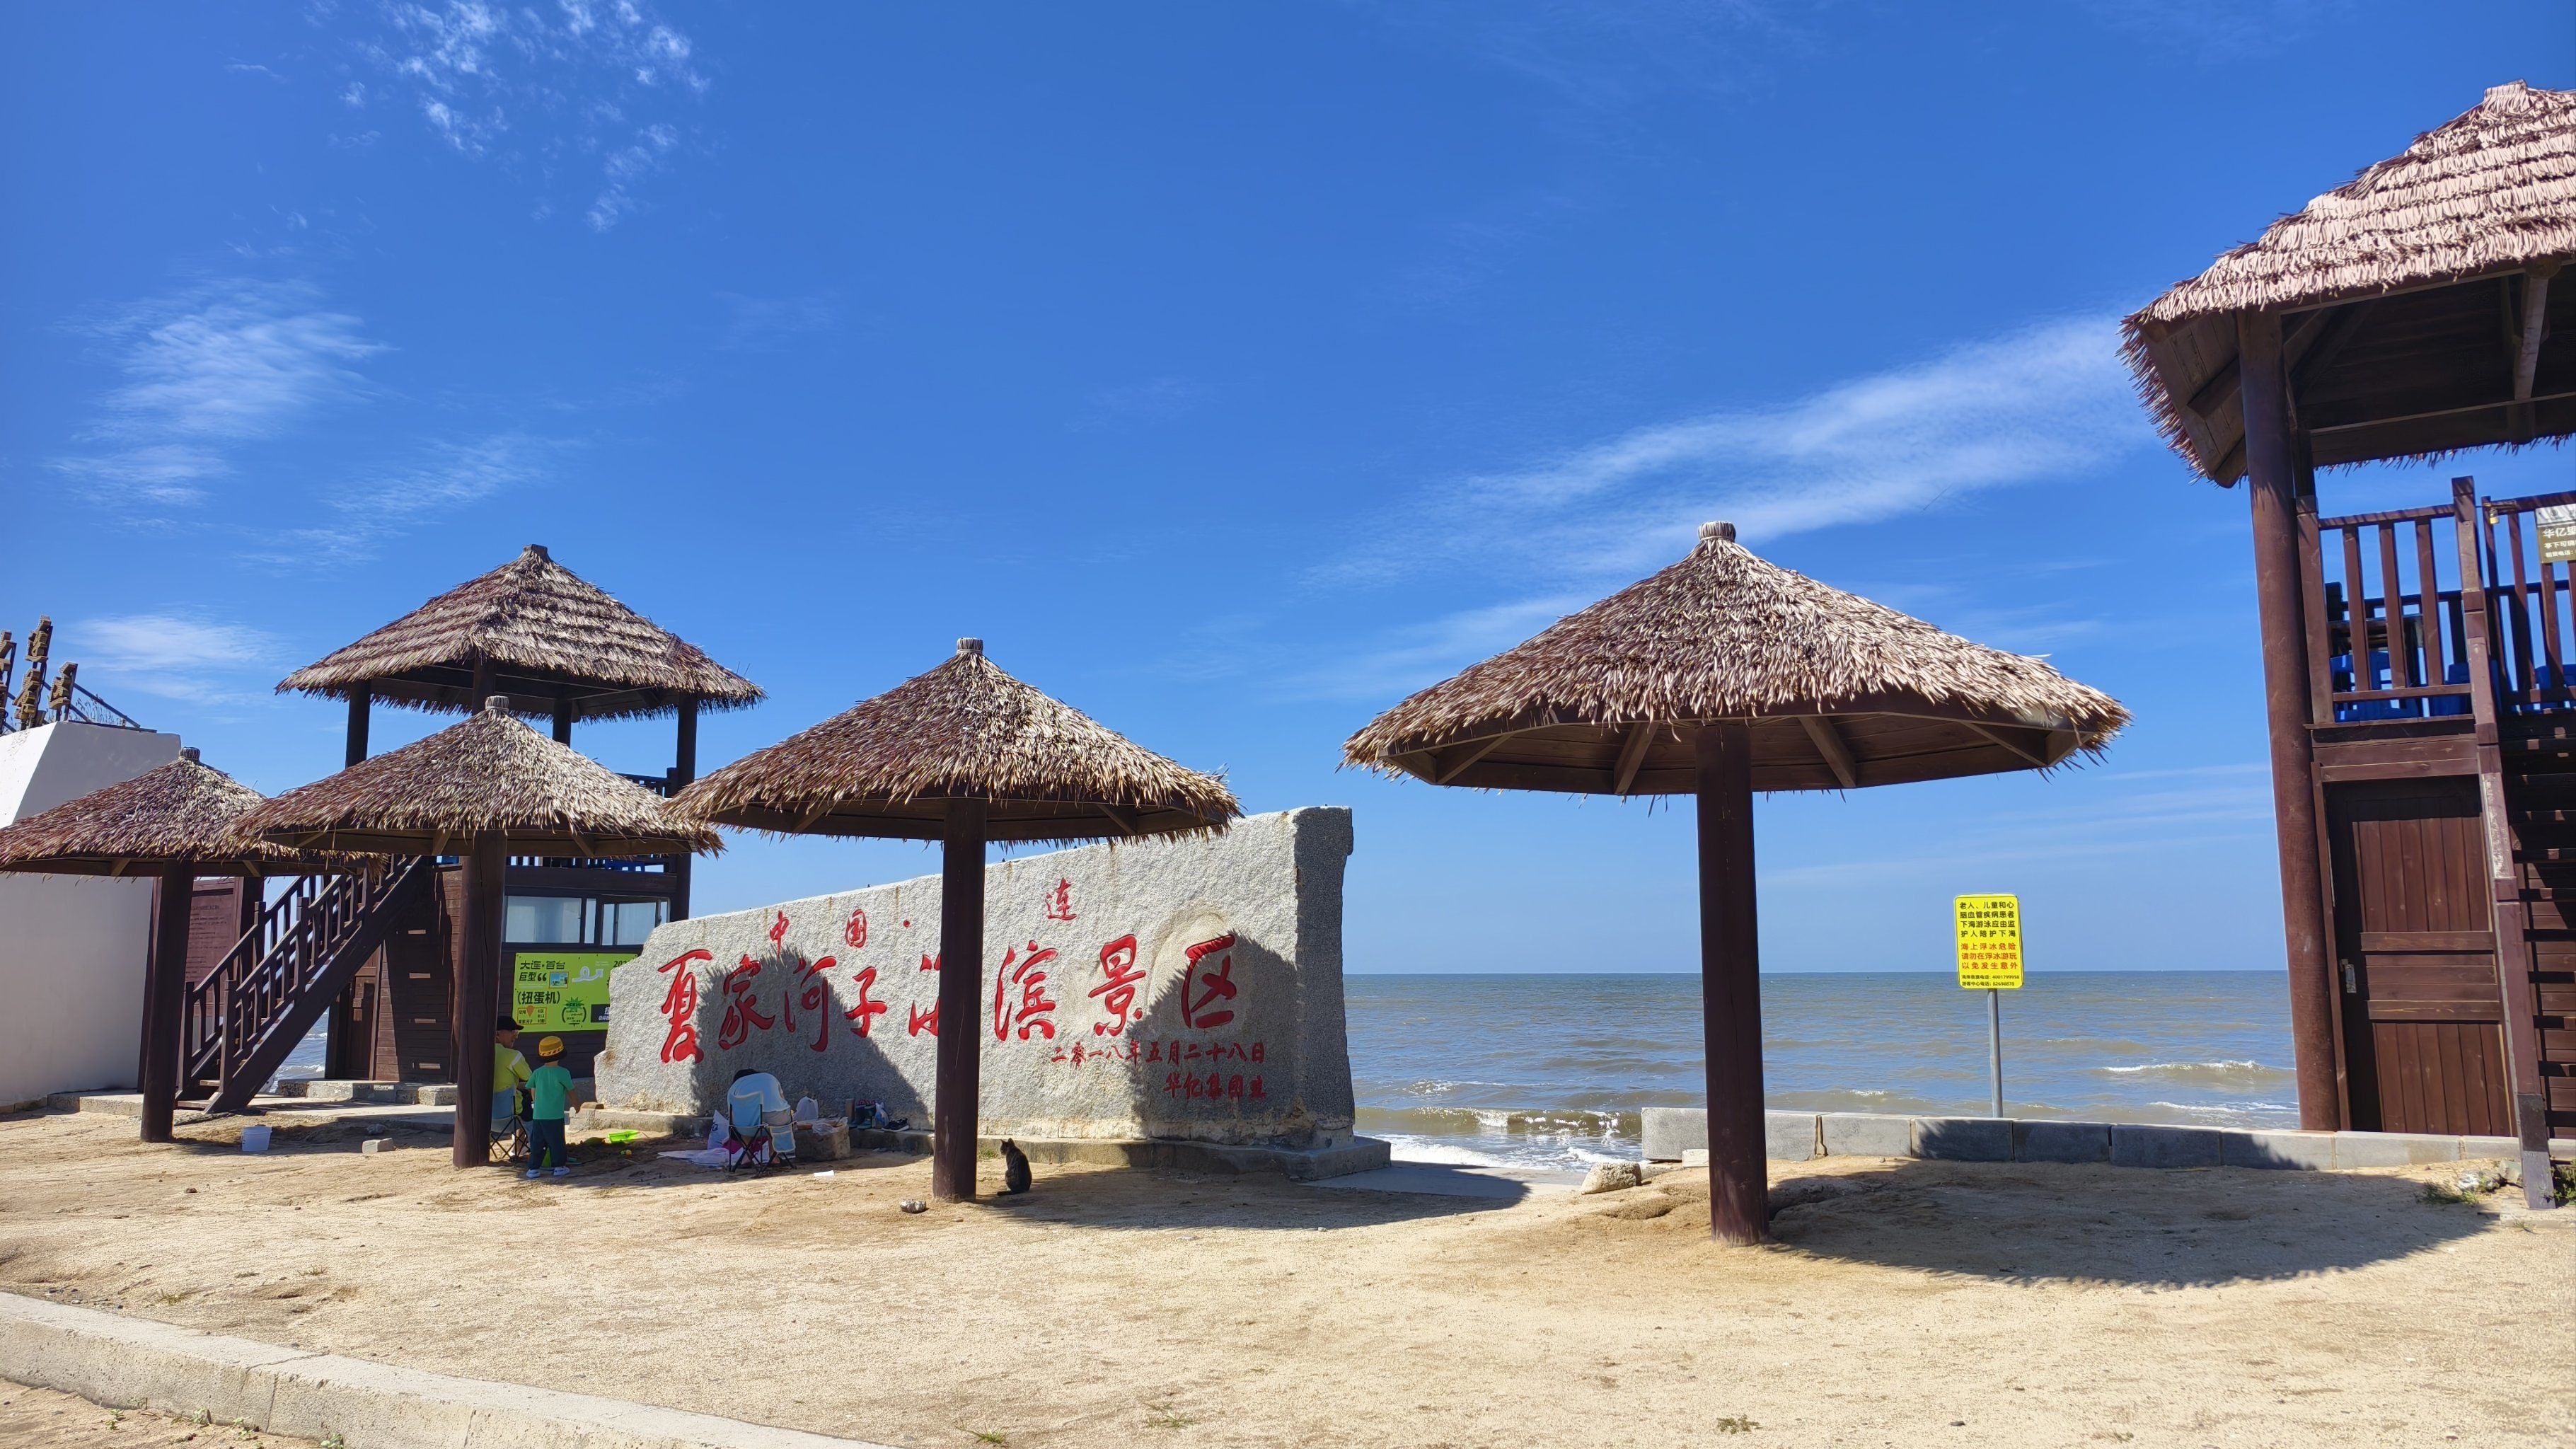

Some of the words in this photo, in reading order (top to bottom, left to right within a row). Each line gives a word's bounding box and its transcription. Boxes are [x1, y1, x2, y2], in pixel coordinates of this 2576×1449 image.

[770, 877, 1078, 957] 中国·连
[520, 960, 565, 970] 大连·首台
[1051, 1039, 1265, 1067] 二零一八年五月二十八日
[1163, 1071, 1266, 1100] 华亿集团建
